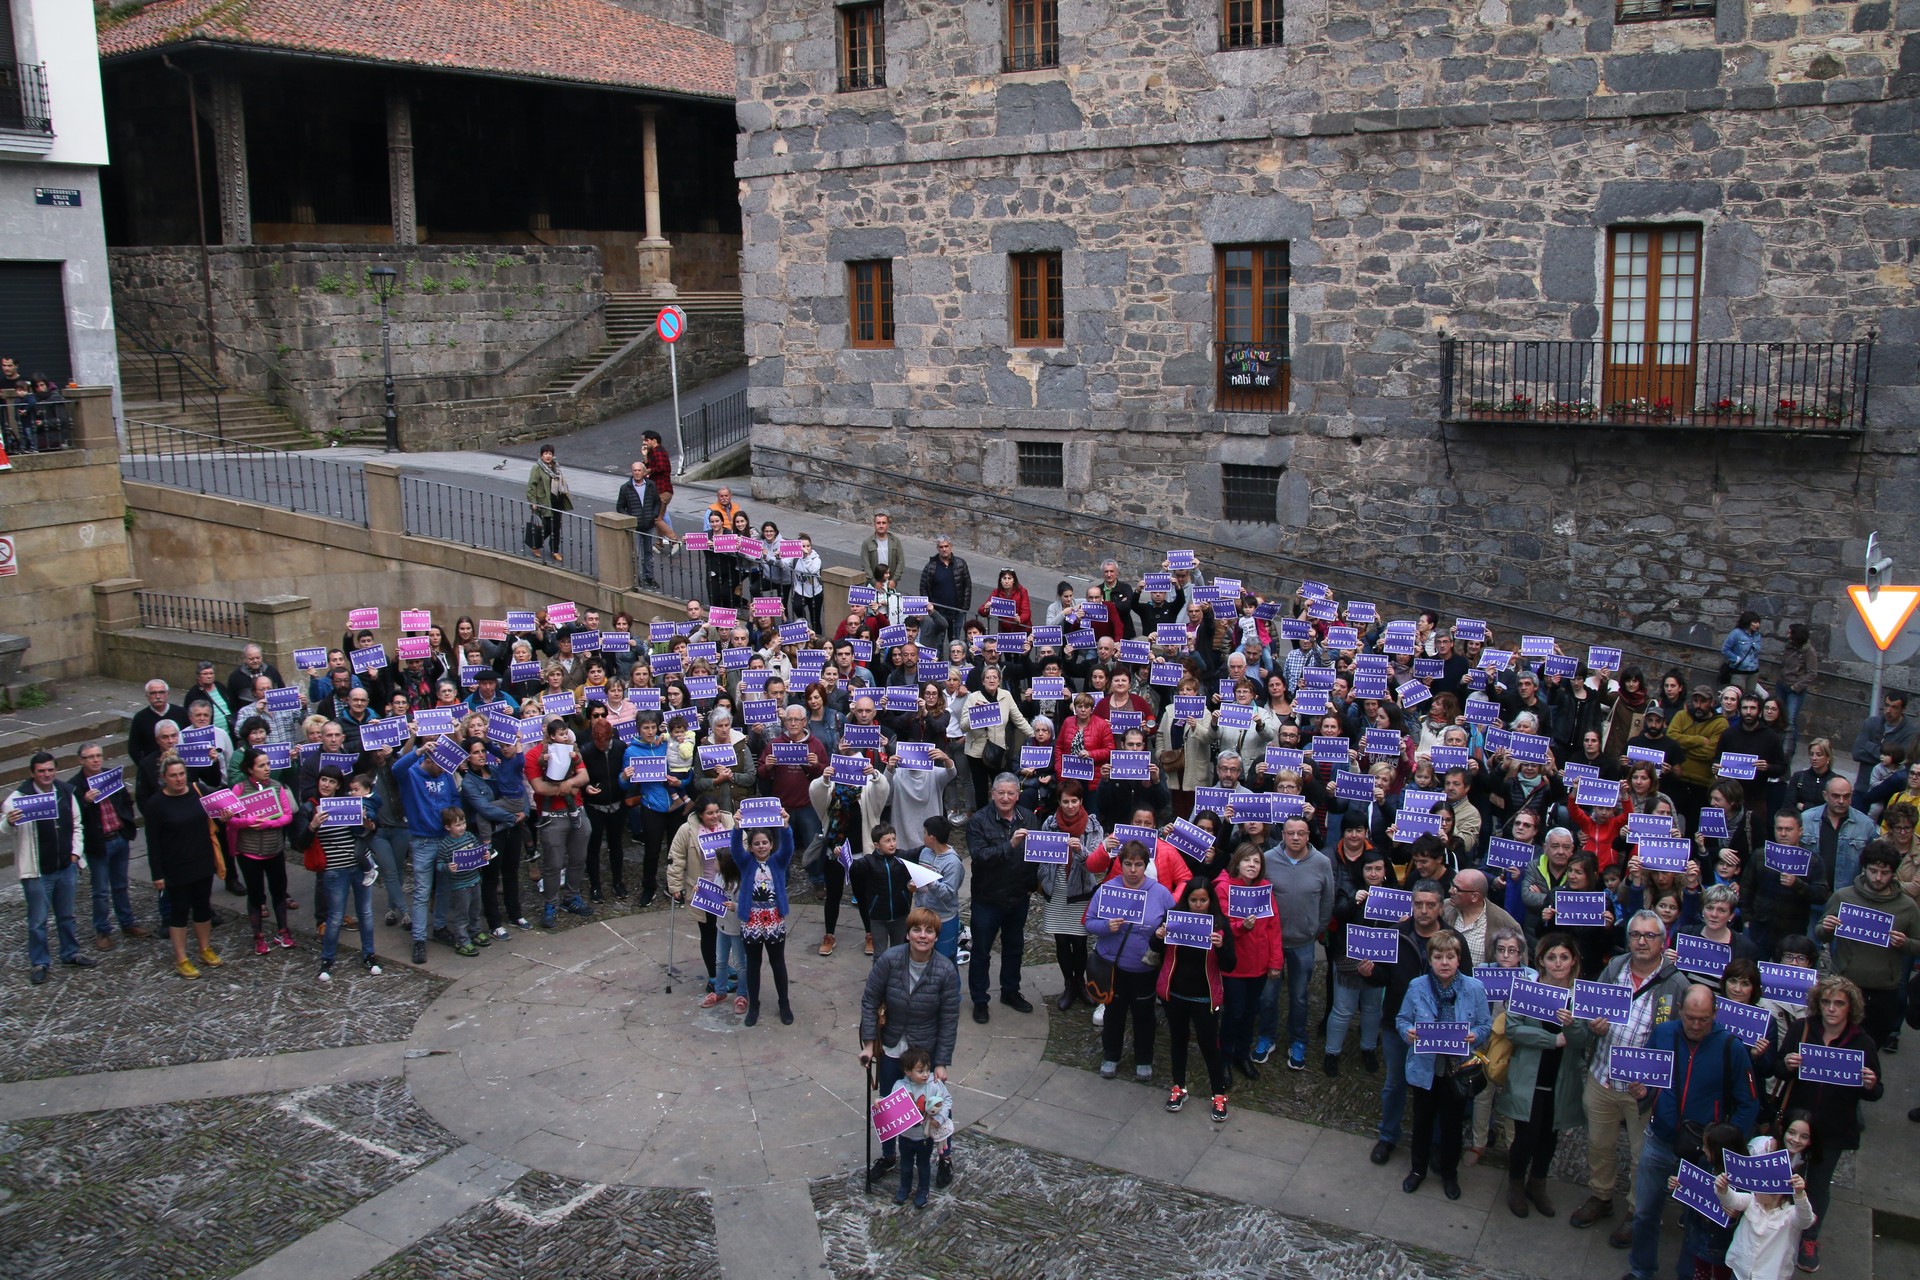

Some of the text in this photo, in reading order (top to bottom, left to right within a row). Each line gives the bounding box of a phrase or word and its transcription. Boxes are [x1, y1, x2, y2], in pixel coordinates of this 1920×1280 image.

[1242, 361, 1260, 372] bizi
[1231, 374, 1270, 386] nahi dut
[352, 648, 381, 658] SINISTEN
[355, 659, 384, 669] ZAITXUT
[1547, 656, 1576, 664] SINISTEN
[1546, 667, 1574, 675] ZAITXUT
[267, 689, 298, 698] SINISTEN
[543, 694, 573, 702] SINISTEN
[546, 706, 574, 714] ZAITXUT
[970, 705, 999, 713] SINISTEN
[1222, 705, 1252, 713] SINISTEN
[490, 715, 519, 727] SINISTEN
[972, 716, 1000, 725] ZAITXUT
[1220, 717, 1250, 725] ZAITXUT
[362, 724, 397, 733] SINISTEN
[365, 737, 398, 746] ZAITXUT
[1513, 736, 1548, 745] SINISTEN
[438, 737, 468, 758] SINISTEN
[1630, 748, 1663, 757] SINISTEN
[1267, 750, 1302, 758] SINISTEN
[702, 756, 734, 765] ZAITXUT
[1566, 764, 1598, 773] SINISTEN
[1338, 774, 1374, 783] SINISTEN
[1580, 780, 1619, 789] SINISTEN
[1336, 788, 1372, 796] ZAITXUT
[1407, 792, 1445, 800] SINISTEN
[13, 796, 55, 806] SINISTEN
[1578, 794, 1614, 803] ZAITXUT
[741, 800, 780, 809] SINISTEN
[740, 815, 782, 824] ZAITXUT
[1398, 814, 1439, 824] SINISTEN
[1630, 817, 1671, 825] SINISTEN
[1116, 827, 1156, 838] SINISTEN
[1176, 820, 1212, 844] SINISTEN
[1028, 833, 1068, 842] SINISTEN
[1168, 833, 1205, 856] ZAITXUT
[1492, 840, 1533, 852] SINISTEN
[1640, 840, 1688, 848] SINISTEN
[1027, 850, 1066, 858] ZAITXUT
[1766, 844, 1809, 856] SINISTEN
[1640, 856, 1686, 866] ZAITXUT
[1766, 859, 1806, 870] ZAITXUT
[1102, 889, 1145, 900] SINISTEN
[1230, 888, 1270, 897] SINISTEN
[1370, 890, 1411, 901] SINISTEN
[694, 897, 724, 912] ZAITXUT
[1230, 904, 1269, 914] ZAITXUT
[1100, 905, 1142, 917] ZAITXUT
[1841, 906, 1890, 923] SINISTEN
[1168, 915, 1211, 925] SINISTEN
[1166, 931, 1209, 942] ZAITXUT
[1349, 928, 1397, 939] SINISTEN
[1838, 924, 1887, 939] ZAITXUT
[1348, 945, 1395, 956] ZAITXUT
[1679, 938, 1728, 953] SINISTEN
[1678, 956, 1726, 969] ZAITXUT
[1760, 966, 1813, 981] SINISTEN
[1514, 982, 1566, 1000] SINISTEN
[1576, 984, 1630, 997] SINISTEN
[1512, 1000, 1554, 1016] ZAITXU
[1575, 1004, 1627, 1018] ZAITXUT
[1416, 1040, 1466, 1048] ZAITXUT
[1613, 1050, 1671, 1061] SINISTEN
[1802, 1048, 1861, 1061] SINISTEN
[1612, 1068, 1668, 1080] ZAITXUT
[1802, 1066, 1860, 1080] ZAITXUT
[1726, 1154, 1787, 1167] SINISTEN
[1727, 1172, 1789, 1187] ZAITXUT
